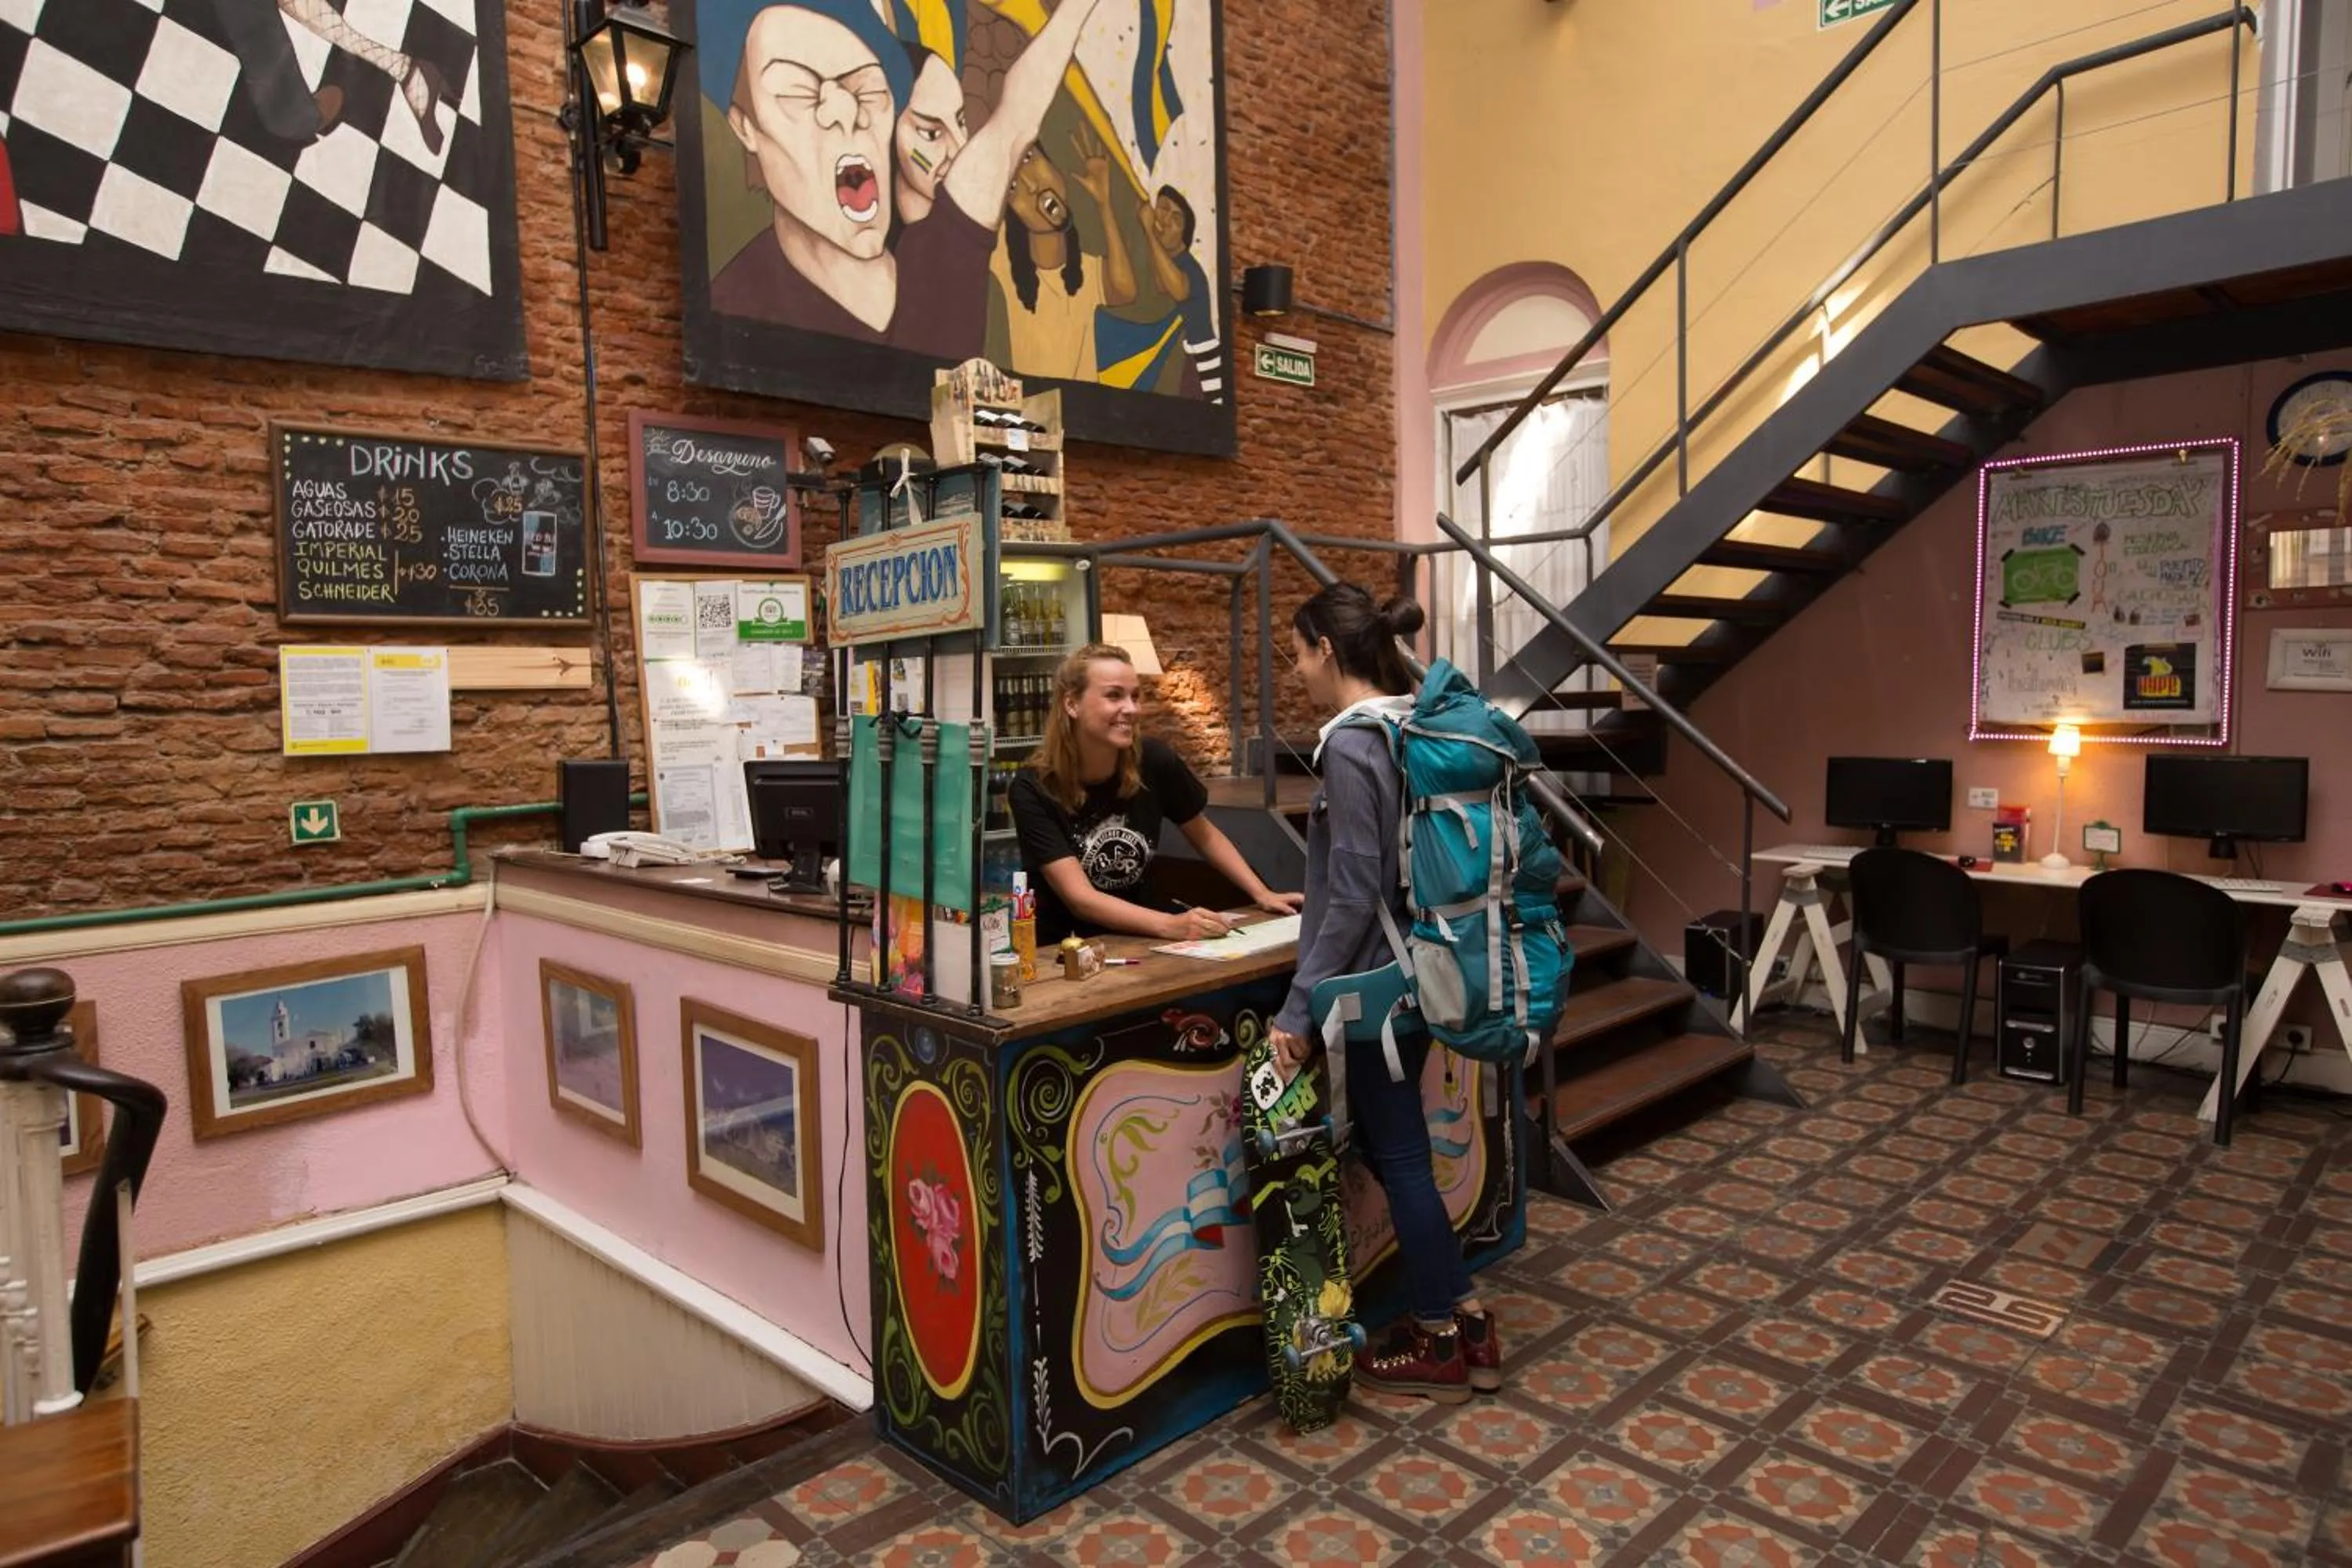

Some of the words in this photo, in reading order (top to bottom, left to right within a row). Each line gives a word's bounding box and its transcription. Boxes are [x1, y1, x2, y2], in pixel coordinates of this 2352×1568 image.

[1276, 355, 1310, 376] SALIDA
[292, 479, 347, 499] AGUAS
[667, 480, 710, 503] 8:30
[291, 499, 376, 518] GASEOSAS
[292, 520, 376, 540] GATORADE
[448, 526, 514, 544] HEINEKEN
[664, 517, 717, 540] 10:30
[292, 541, 387, 561] IMPERIAL
[449, 543, 501, 561] STELLA
[297, 557, 384, 579] QUILMES
[449, 563, 509, 583] CORONA
[840, 543, 958, 619] RECEPCION
[299, 580, 395, 603] SCHNEIDER
